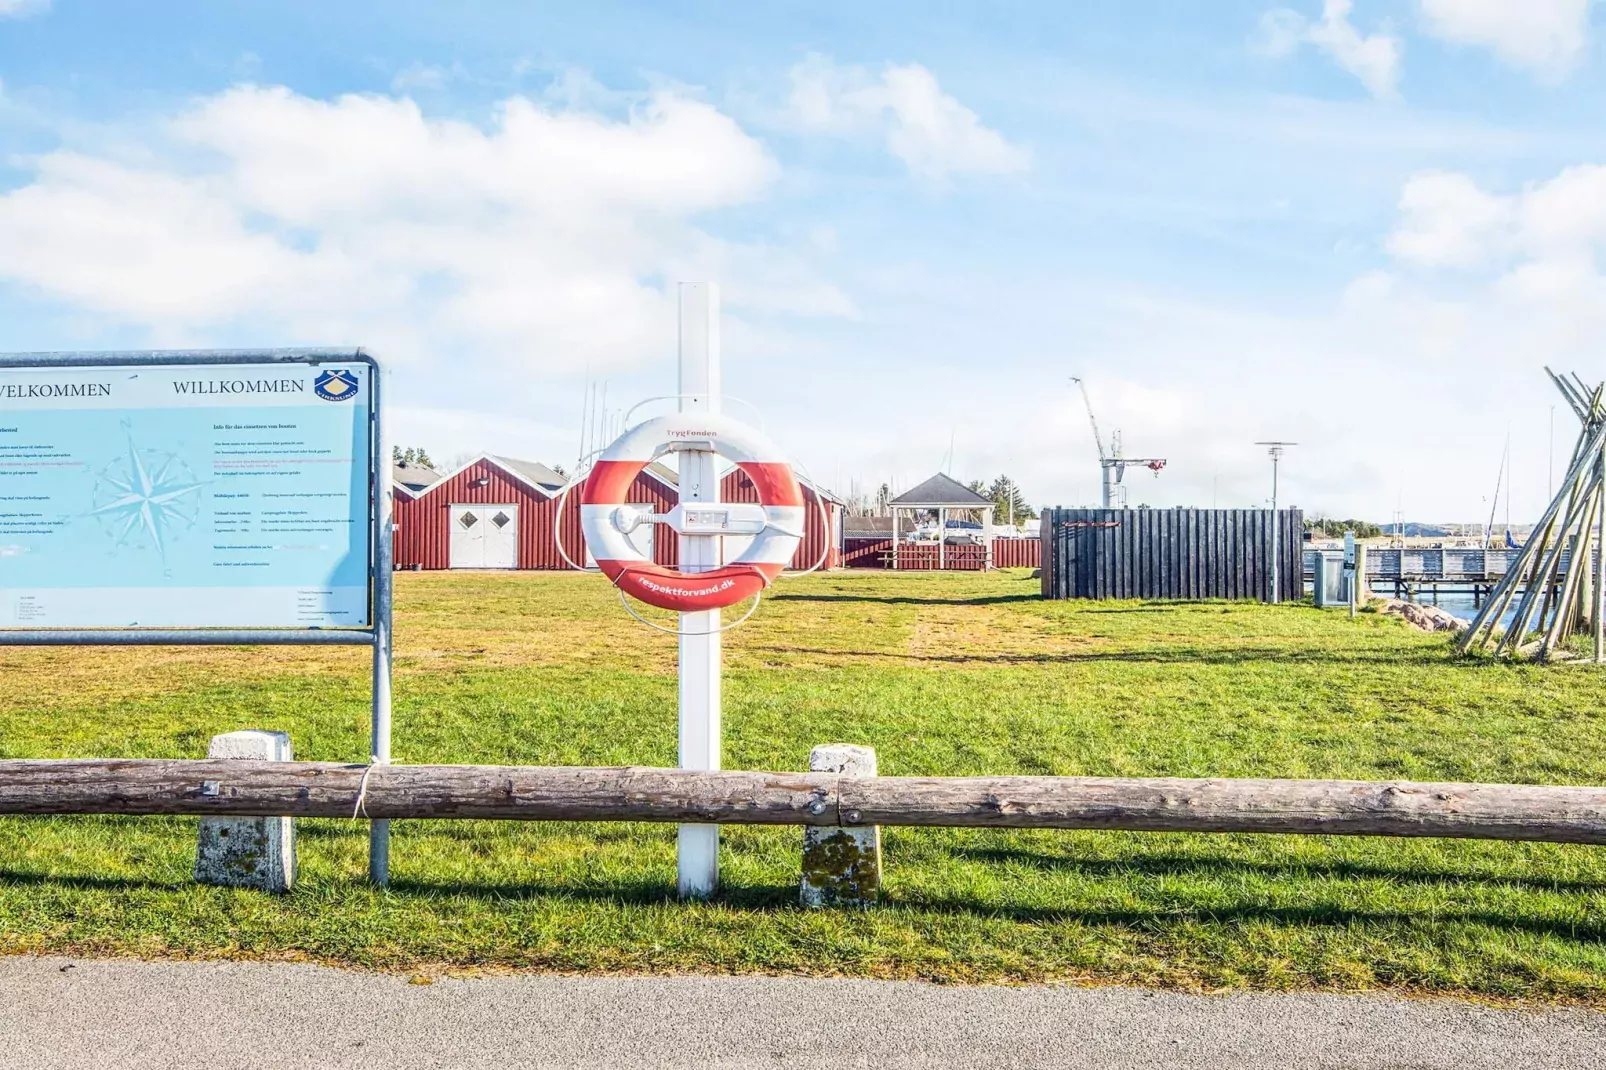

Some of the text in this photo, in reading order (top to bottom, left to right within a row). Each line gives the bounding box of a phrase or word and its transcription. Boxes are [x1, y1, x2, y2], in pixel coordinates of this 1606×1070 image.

[173, 379, 305, 394] WILLKOMMEN
[667, 430, 717, 438] TrygFonden
[639, 577, 735, 597] respektforvand.dk
